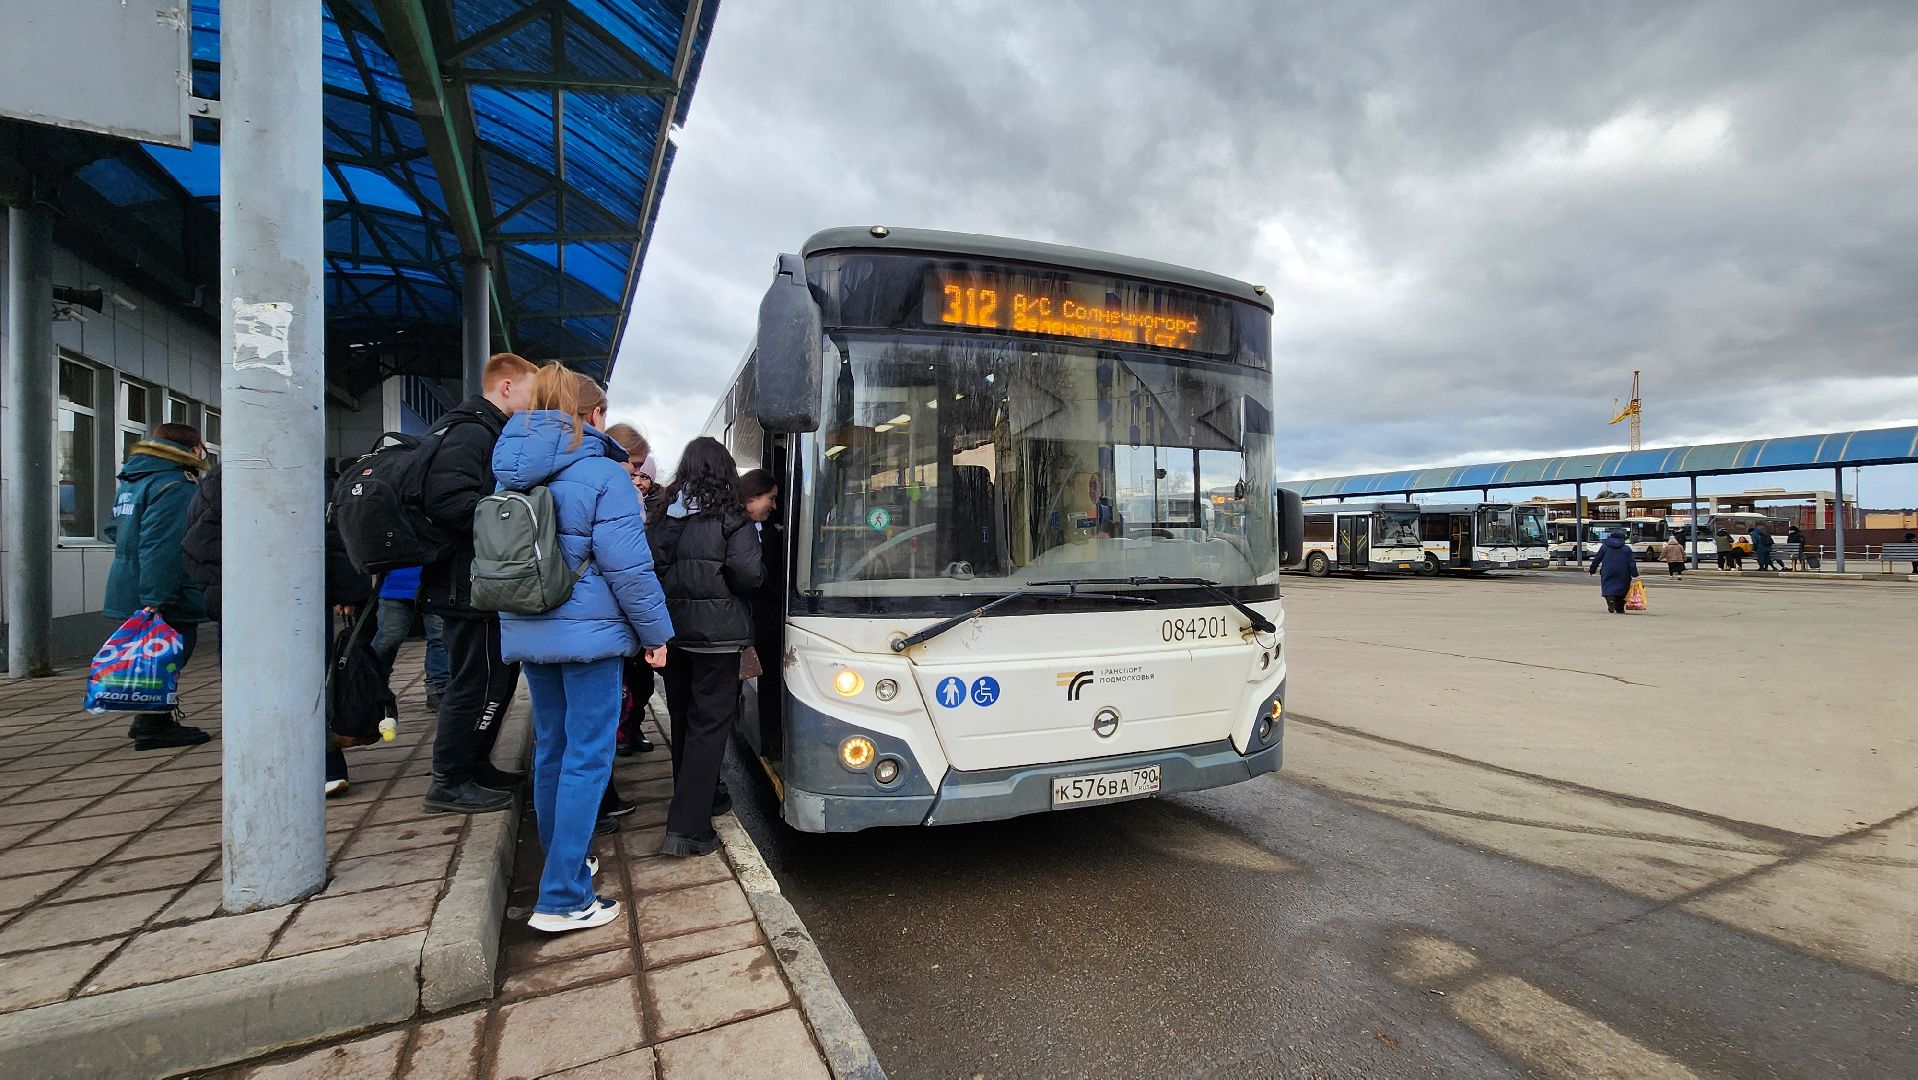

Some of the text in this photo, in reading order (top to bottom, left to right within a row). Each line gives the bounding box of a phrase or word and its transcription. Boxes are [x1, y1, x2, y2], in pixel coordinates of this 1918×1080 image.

[942, 284, 997, 328] 312
[1013, 293, 1051, 316] А/С
[1162, 616, 1228, 642] 084201
[1099, 673, 1155, 684] ПОДМОСКОВЬЯ
[95, 691, 162, 702] ozon банк
[478, 701, 500, 730] RUN
[1060, 768, 1156, 801] К576ВА 790
